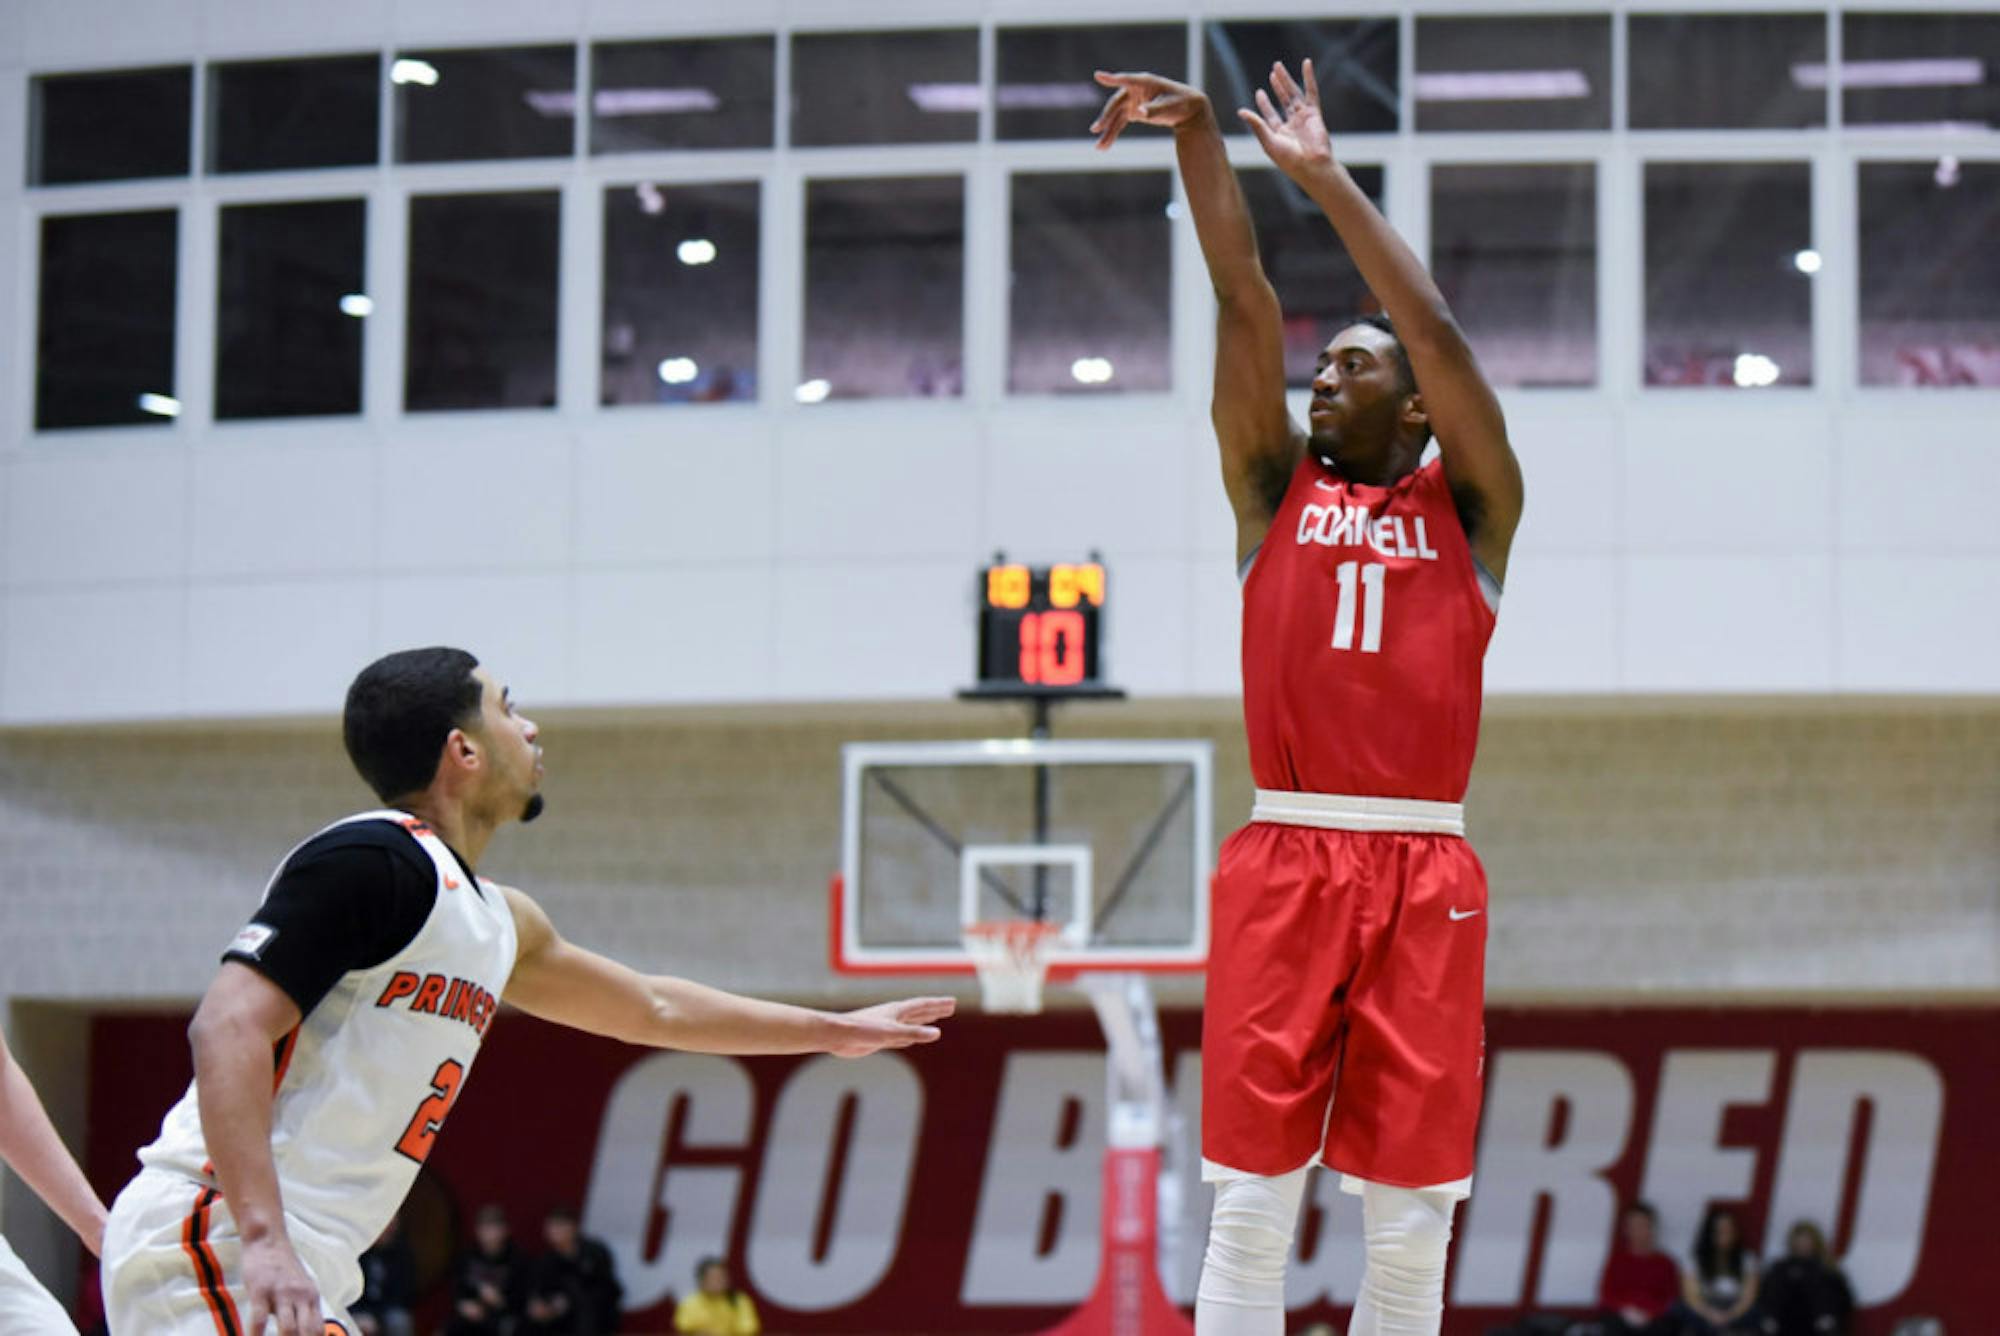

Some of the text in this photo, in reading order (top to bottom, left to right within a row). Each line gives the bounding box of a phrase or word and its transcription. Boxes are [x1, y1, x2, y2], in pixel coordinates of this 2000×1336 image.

[1019, 610, 1085, 686] 10
[1331, 560, 1386, 653] 11
[394, 1057, 463, 1164] 2
[580, 1051, 926, 1312] GO
[1453, 1048, 1946, 1310] RED
